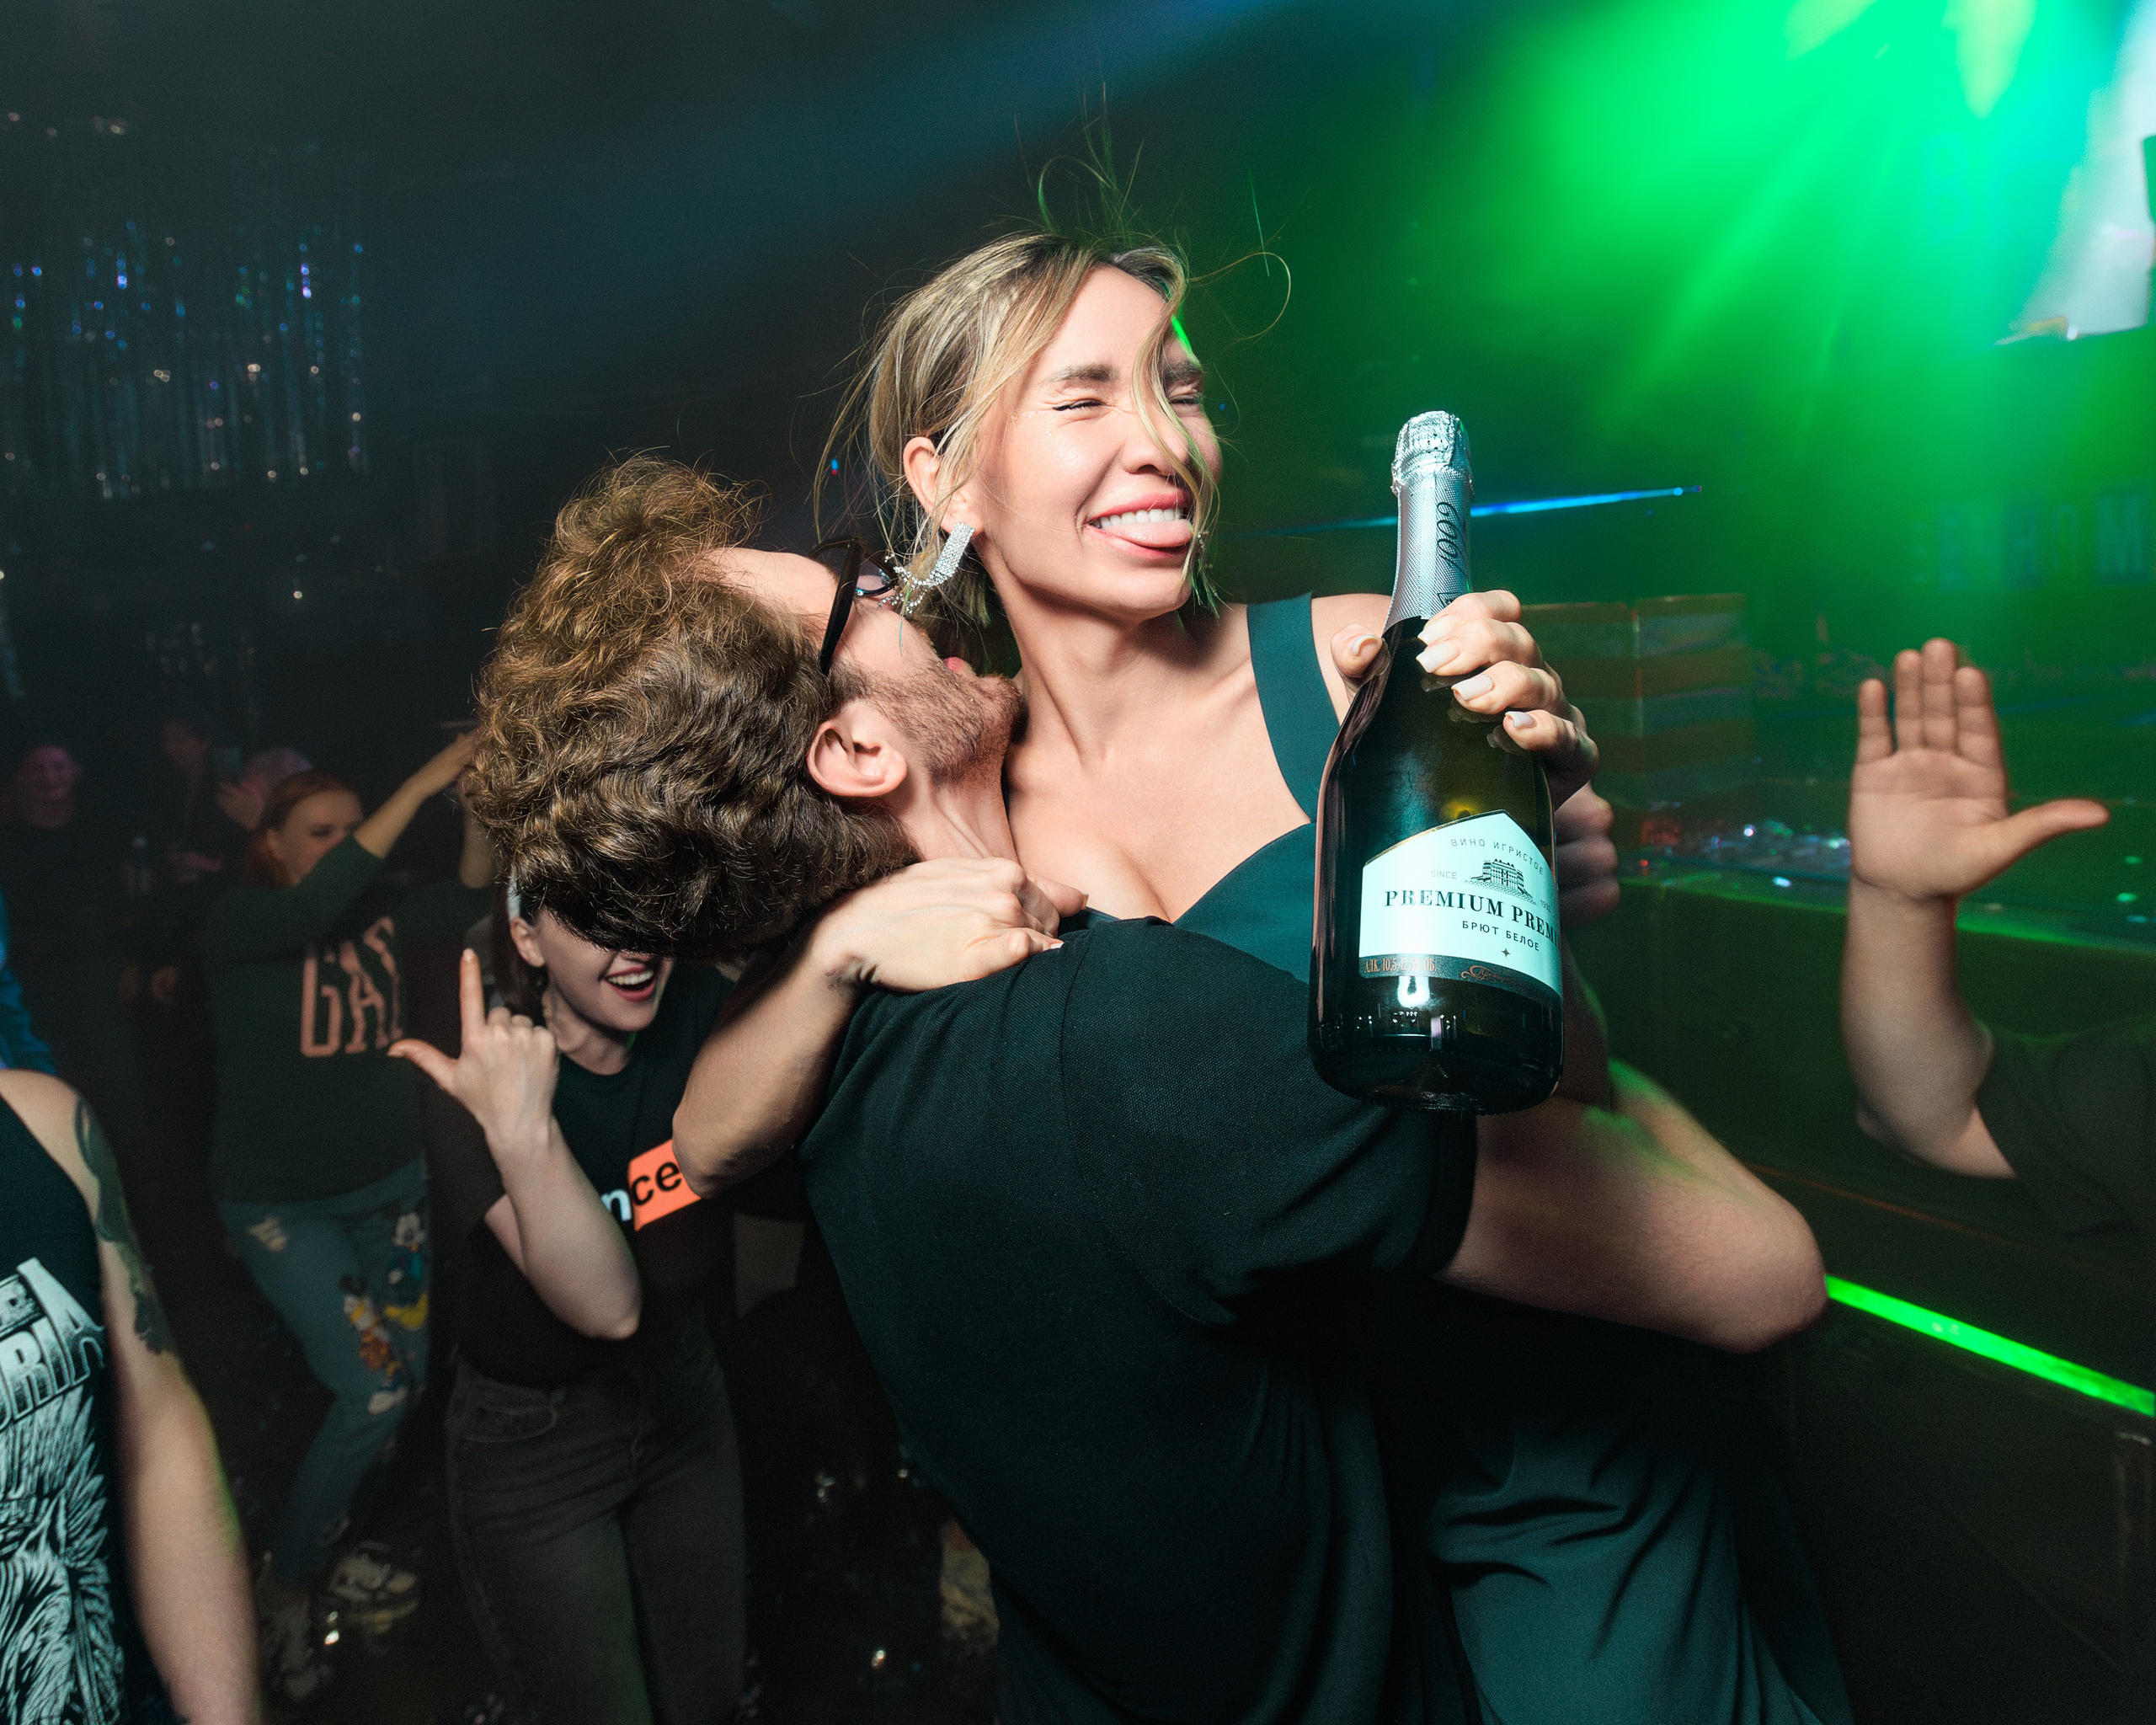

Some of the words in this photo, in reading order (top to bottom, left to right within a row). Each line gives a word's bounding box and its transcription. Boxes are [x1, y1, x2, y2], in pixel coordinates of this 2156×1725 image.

[1450, 838, 1486, 847] ВИНО
[1493, 841, 1545, 876] ИГРИСТОЕ
[1430, 870, 1457, 879] SINCE
[1384, 889, 1504, 918] PREMIUM
[1462, 921, 1499, 935] БРЮТ
[1506, 930, 1540, 952] БЕЛОЕ
